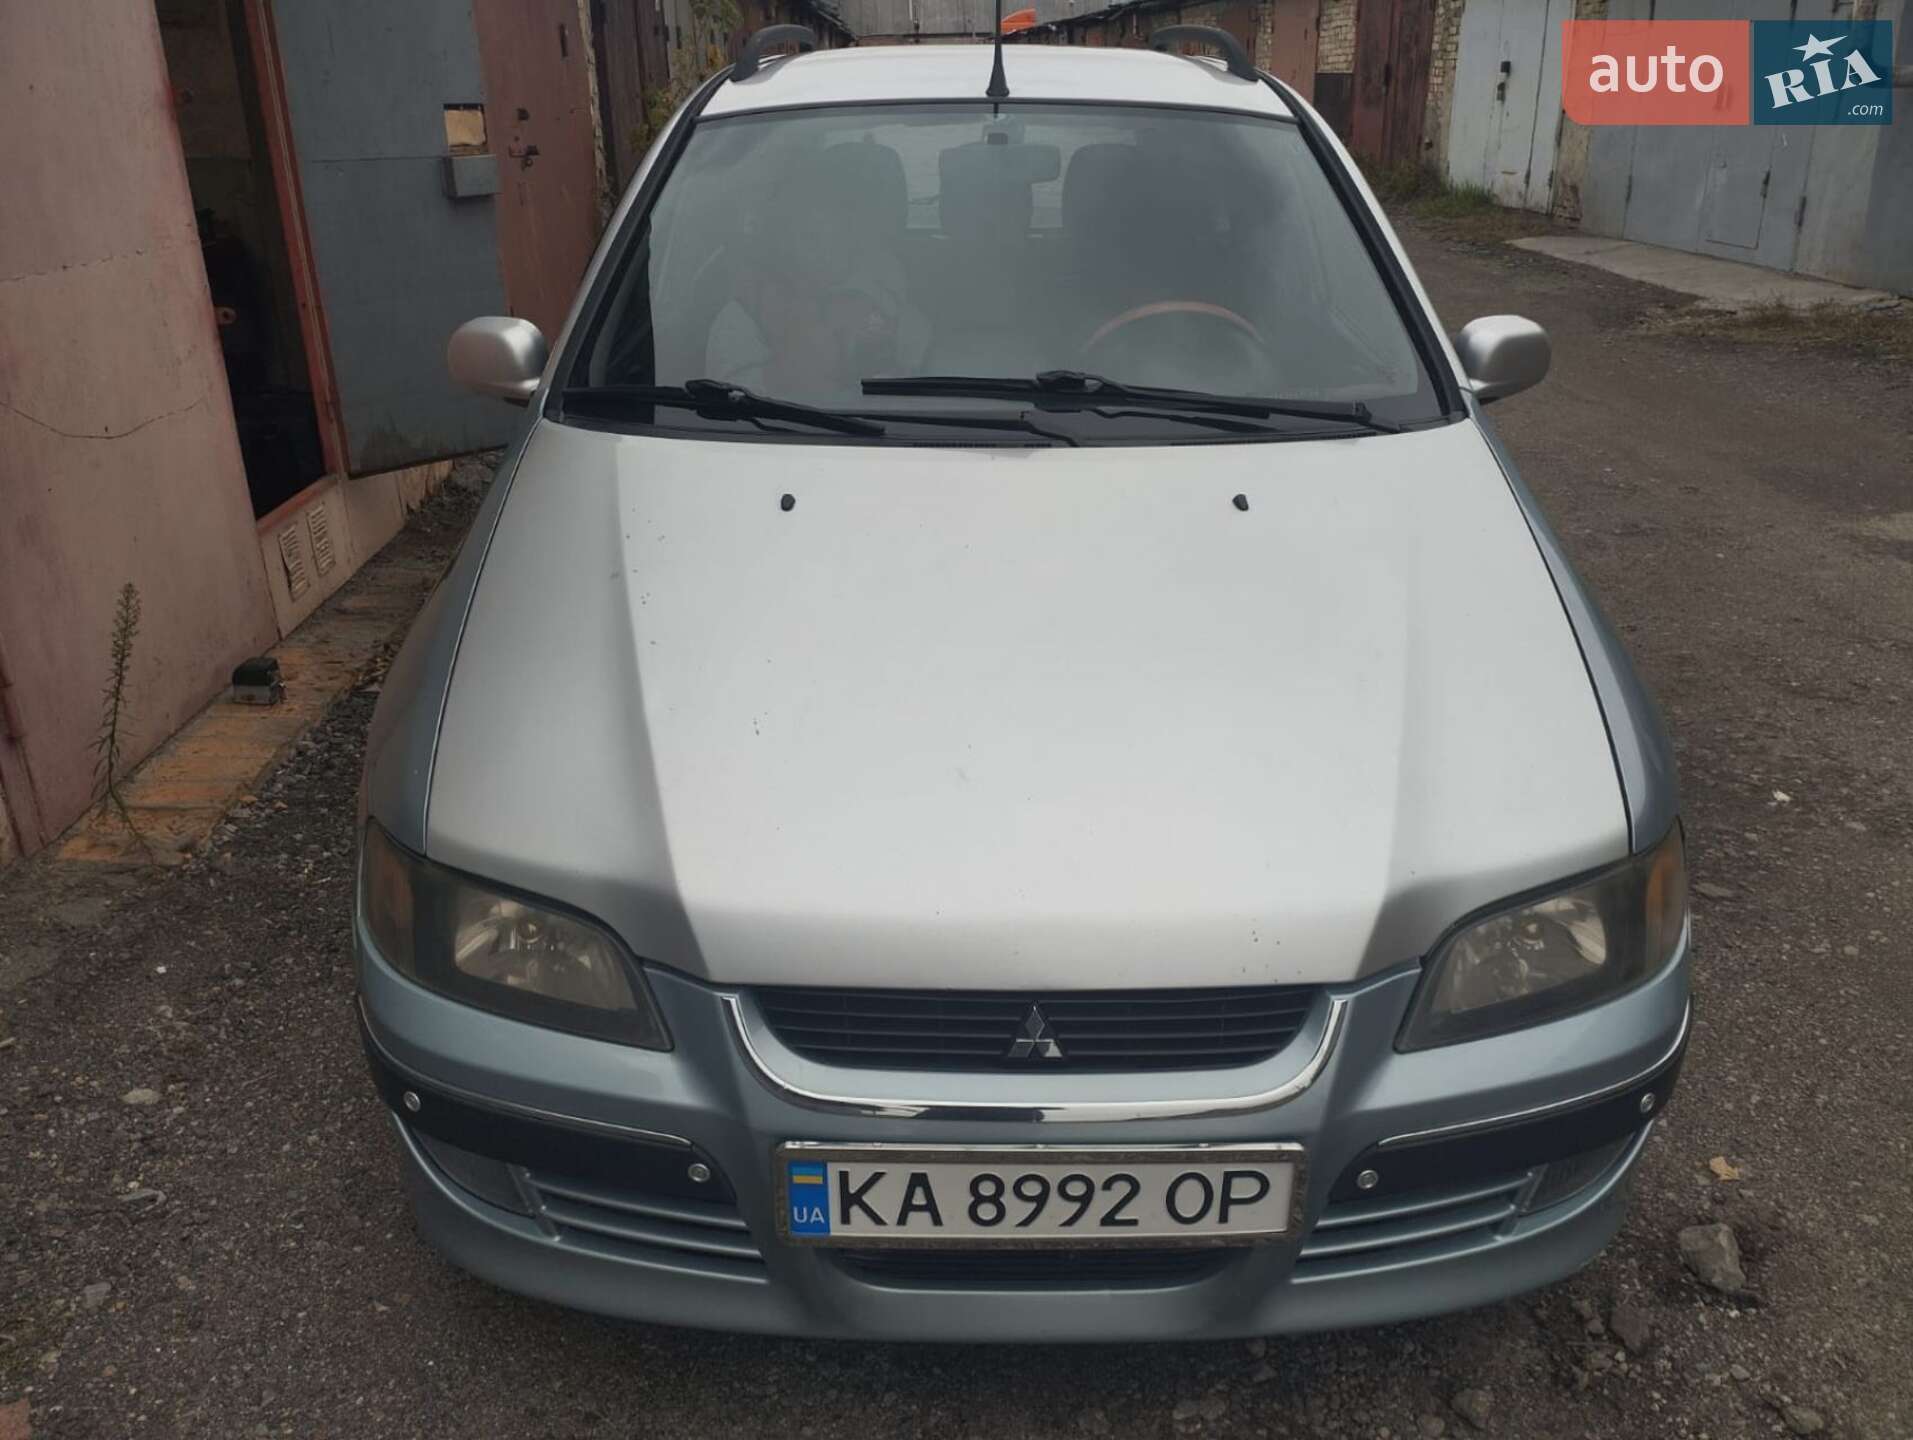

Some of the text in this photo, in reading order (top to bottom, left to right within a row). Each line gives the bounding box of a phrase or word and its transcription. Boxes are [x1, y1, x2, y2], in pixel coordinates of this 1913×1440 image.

[793, 1206, 825, 1225] UA
[838, 1169, 1271, 1228] KA 8992 OP
